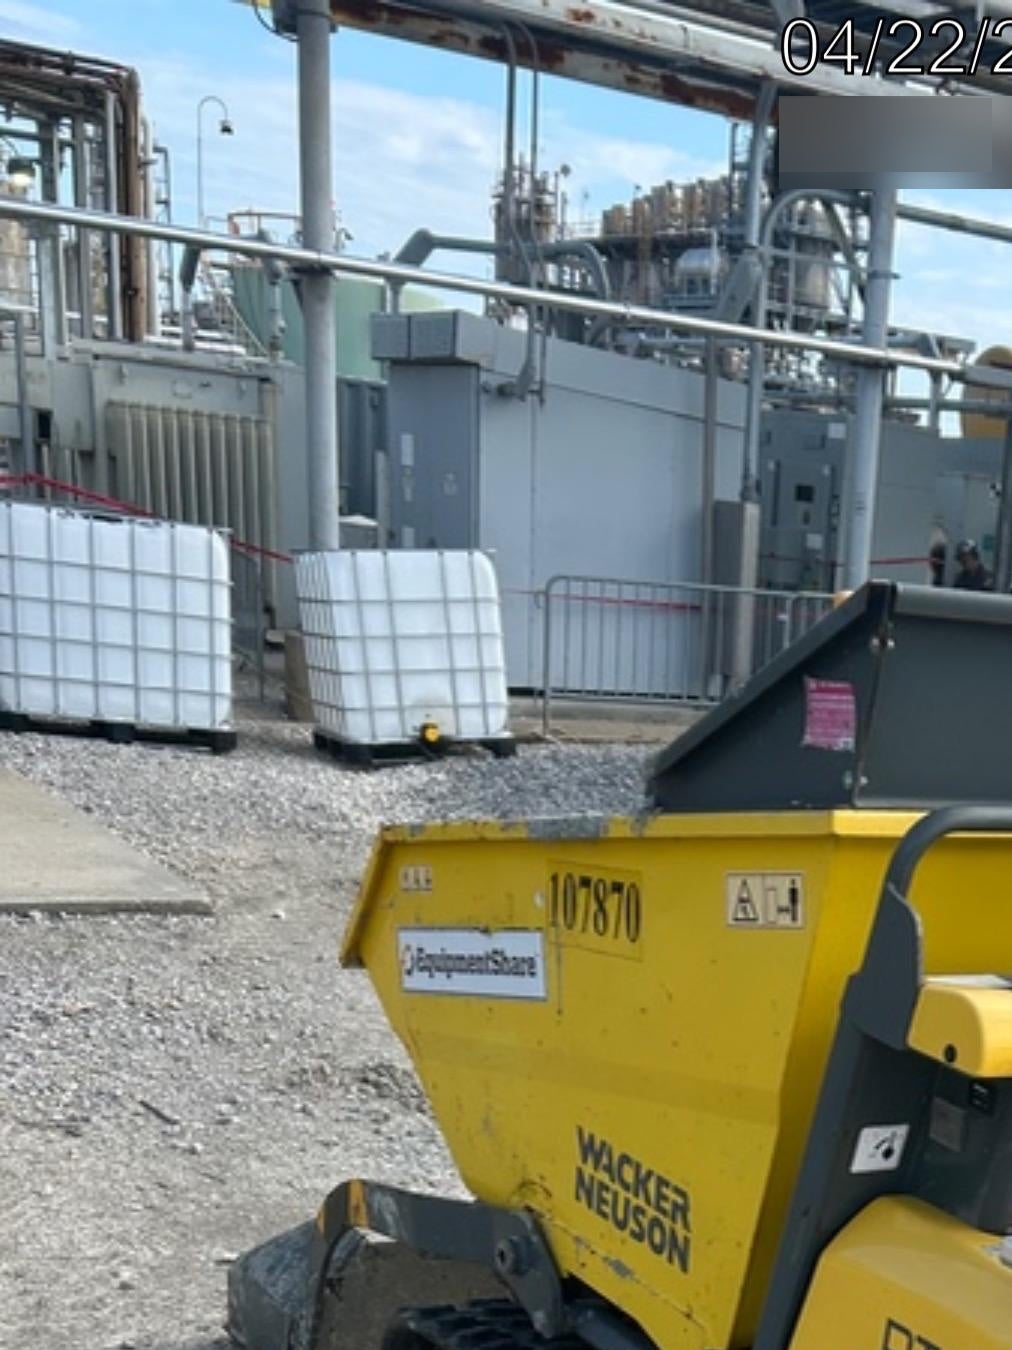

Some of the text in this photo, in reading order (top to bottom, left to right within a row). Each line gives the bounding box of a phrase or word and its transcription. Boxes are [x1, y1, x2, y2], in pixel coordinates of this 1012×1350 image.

[550, 871, 640, 942] 107870
[415, 946, 537, 979] EquipmentShare
[575, 1125, 692, 1232] WACKER
[575, 1166, 690, 1274] NEUSON
